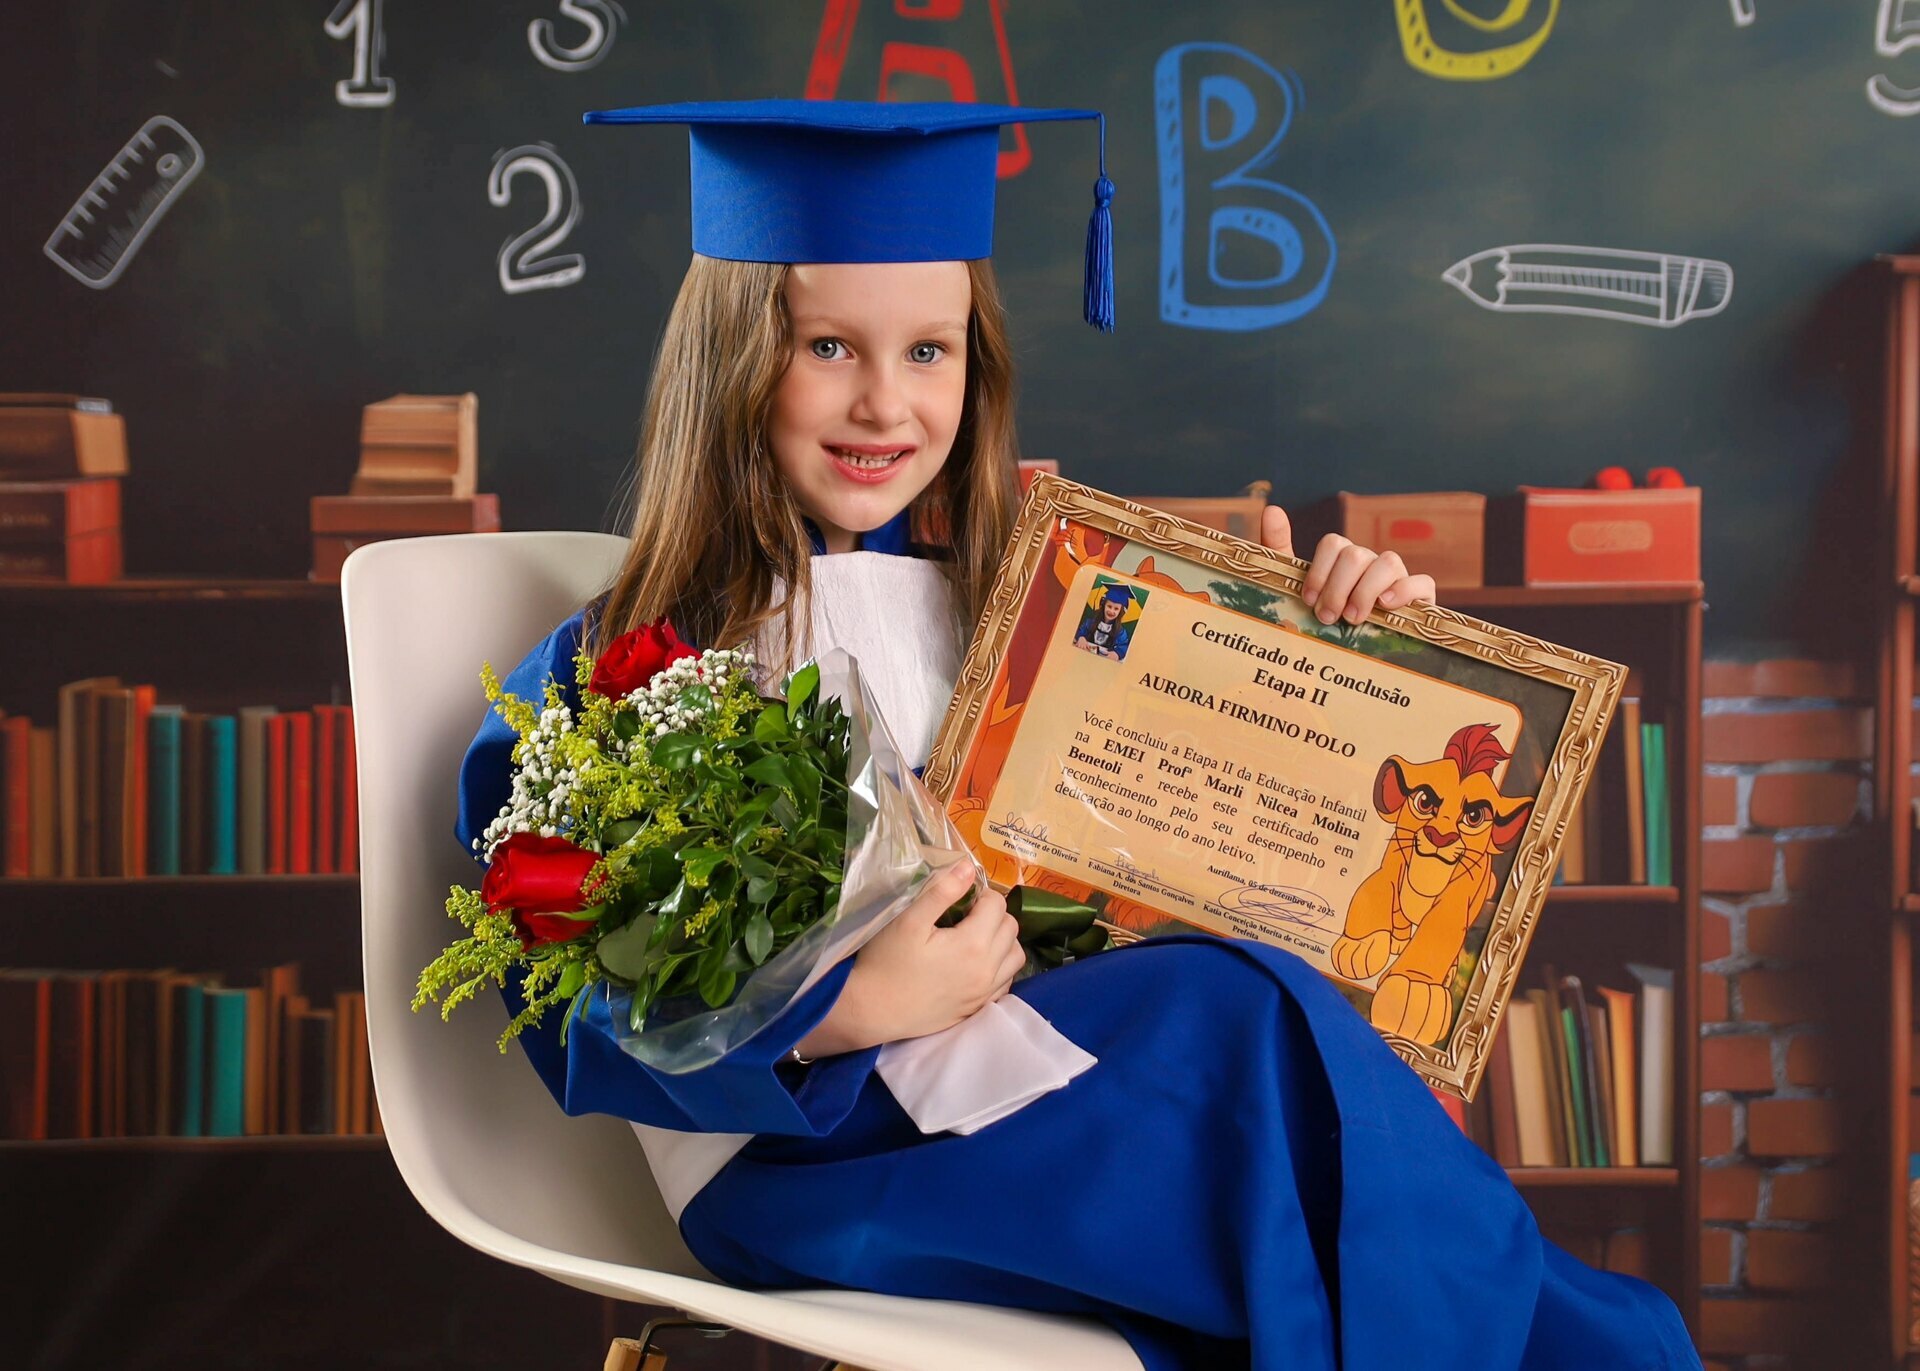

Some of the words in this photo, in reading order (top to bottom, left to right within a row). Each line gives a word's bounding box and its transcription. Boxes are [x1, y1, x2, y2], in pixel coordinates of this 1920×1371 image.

[324, 0, 396, 107] 1
[488, 140, 586, 294] 2
[1154, 42, 1337, 332] B
[1191, 621, 1289, 666] Certificado
[1292, 655, 1315, 676] de
[1318, 665, 1411, 708] Conclusão
[1251, 667, 1306, 700] Etapa
[1308, 687, 1330, 707] II
[1138, 672, 1215, 710] AURORA
[1217, 698, 1300, 738] FIRMINO
[1301, 727, 1356, 757] POLO
[1066, 744, 1123, 775] Benetoli
[1135, 773, 1143, 783] e
[1157, 780, 1198, 803] recebe
[1212, 800, 1238, 817] este
[1252, 815, 1319, 846] certificado
[1333, 844, 1354, 859] em
[1074, 730, 1090, 744] na
[1102, 737, 1146, 763] EMEI
[1203, 774, 1244, 799] Marli
[1255, 792, 1298, 819] Nilcea
[1310, 812, 1360, 841] Molina
[1084, 710, 1114, 732] Você
[1115, 725, 1168, 752] concluiu
[1170, 745, 1179, 756] a
[1182, 746, 1218, 770] Etapa
[1220, 760, 1234, 775] II
[1236, 766, 1252, 782] da
[1255, 772, 1316, 804] Educação
[1319, 794, 1367, 822] Infantil
[1041, 844, 1050, 852] de
[1050, 847, 1080, 863] Oliveira
[1054, 780, 1115, 812] dedicação
[1116, 805, 1133, 818] ao
[1134, 808, 1171, 832] longo
[1172, 823, 1189, 839] do
[1191, 833, 1215, 848] ano
[1216, 838, 1255, 864] letivo.
[1060, 765, 1158, 808] reconhecimento
[1168, 805, 1198, 822] pelo
[1210, 820, 1233, 836] seu
[1246, 830, 1325, 868] desempenho
[1339, 866, 1348, 877] e
[1087, 860, 1115, 877] Fabiana
[1114, 871, 1123, 880] A.
[1137, 879, 1163, 893] Santos
[1160, 887, 1195, 906] Gonçalves
[1112, 879, 1141, 896] Diretora
[1206, 864, 1246, 886] Auriflama,
[1257, 884, 1268, 893] de
[1268, 886, 1306, 906] dezembro
[1306, 901, 1316, 910] de
[1202, 903, 1222, 916] Katia
[1222, 911, 1260, 929] Conceição
[1257, 924, 1282, 939] Morita
[1282, 933, 1292, 943] de
[1293, 938, 1326, 955] Carvalho
[1231, 924, 1259, 940] Prefeita
